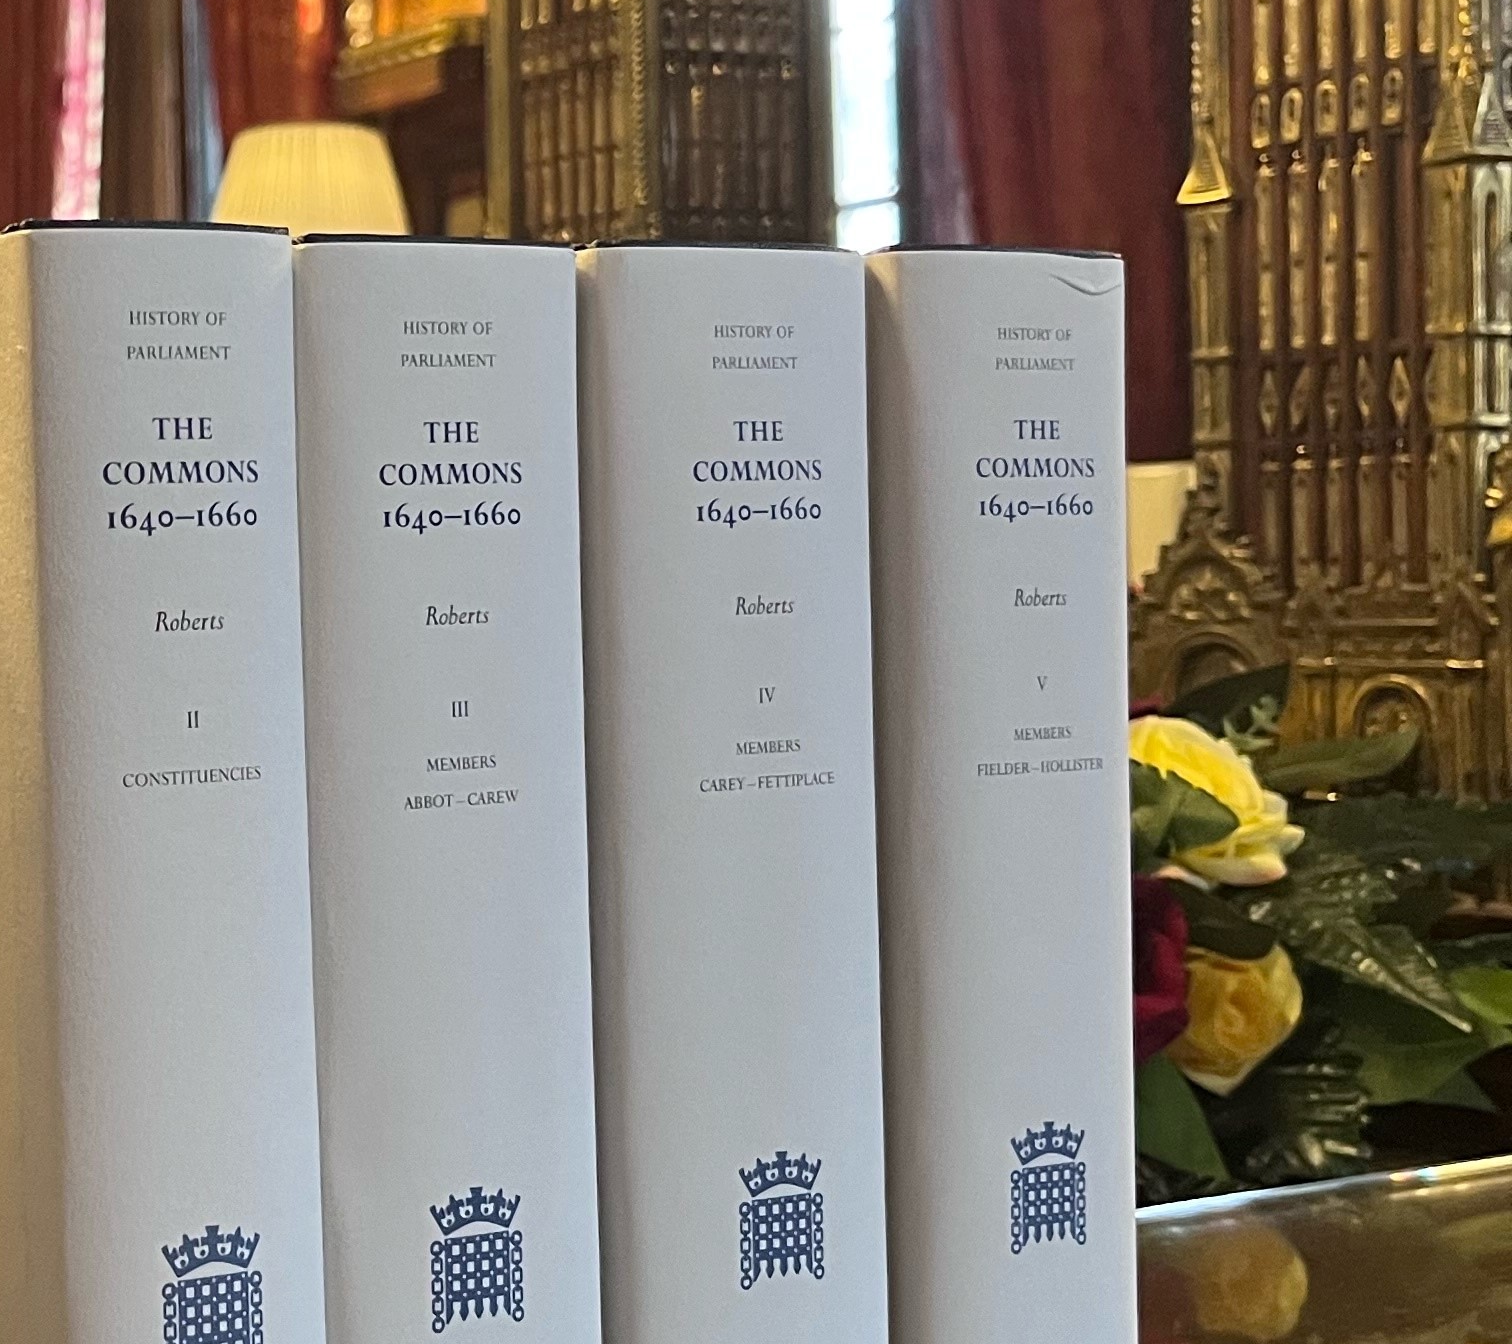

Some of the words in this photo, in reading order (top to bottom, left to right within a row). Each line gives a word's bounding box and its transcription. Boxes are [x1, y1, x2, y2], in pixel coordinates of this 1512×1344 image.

[129, 310, 200, 326] HISTORY
[205, 311, 227, 327] OF
[403, 320, 468, 336] HISTORY
[472, 320, 493, 336] OF
[714, 324, 773, 339] HISTORY
[775, 324, 795, 340] OF
[997, 326, 1053, 342] HISTORY
[1055, 328, 1072, 342] OF
[126, 345, 232, 361] PARLIAMENT
[400, 353, 497, 368] PARLIAMENT
[712, 355, 799, 370] PARLIAMENT
[995, 356, 1076, 371] PARLIAMENT
[151, 416, 213, 441] THE
[423, 421, 479, 444] THE
[733, 420, 784, 442] THE
[1013, 419, 1061, 441] THE
[102, 459, 259, 486] COMMONS
[378, 461, 523, 487] COMMONS
[692, 459, 822, 483] COMMONS
[975, 457, 1095, 479] COMMONS
[735, 594, 795, 616] Roberts
[1013, 586, 1067, 608] Roberts
[154, 609, 225, 633] Roberts
[425, 604, 490, 626] Roberts
[1036, 675, 1048, 691] V
[758, 686, 776, 705] IV
[451, 700, 469, 718] III
[187, 710, 199, 729] II
[1013, 725, 1072, 742] MEMBERS
[735, 738, 802, 756] MEMBERS
[426, 754, 497, 773] MEMBERS
[122, 765, 262, 789] CONSTITUENCIES
